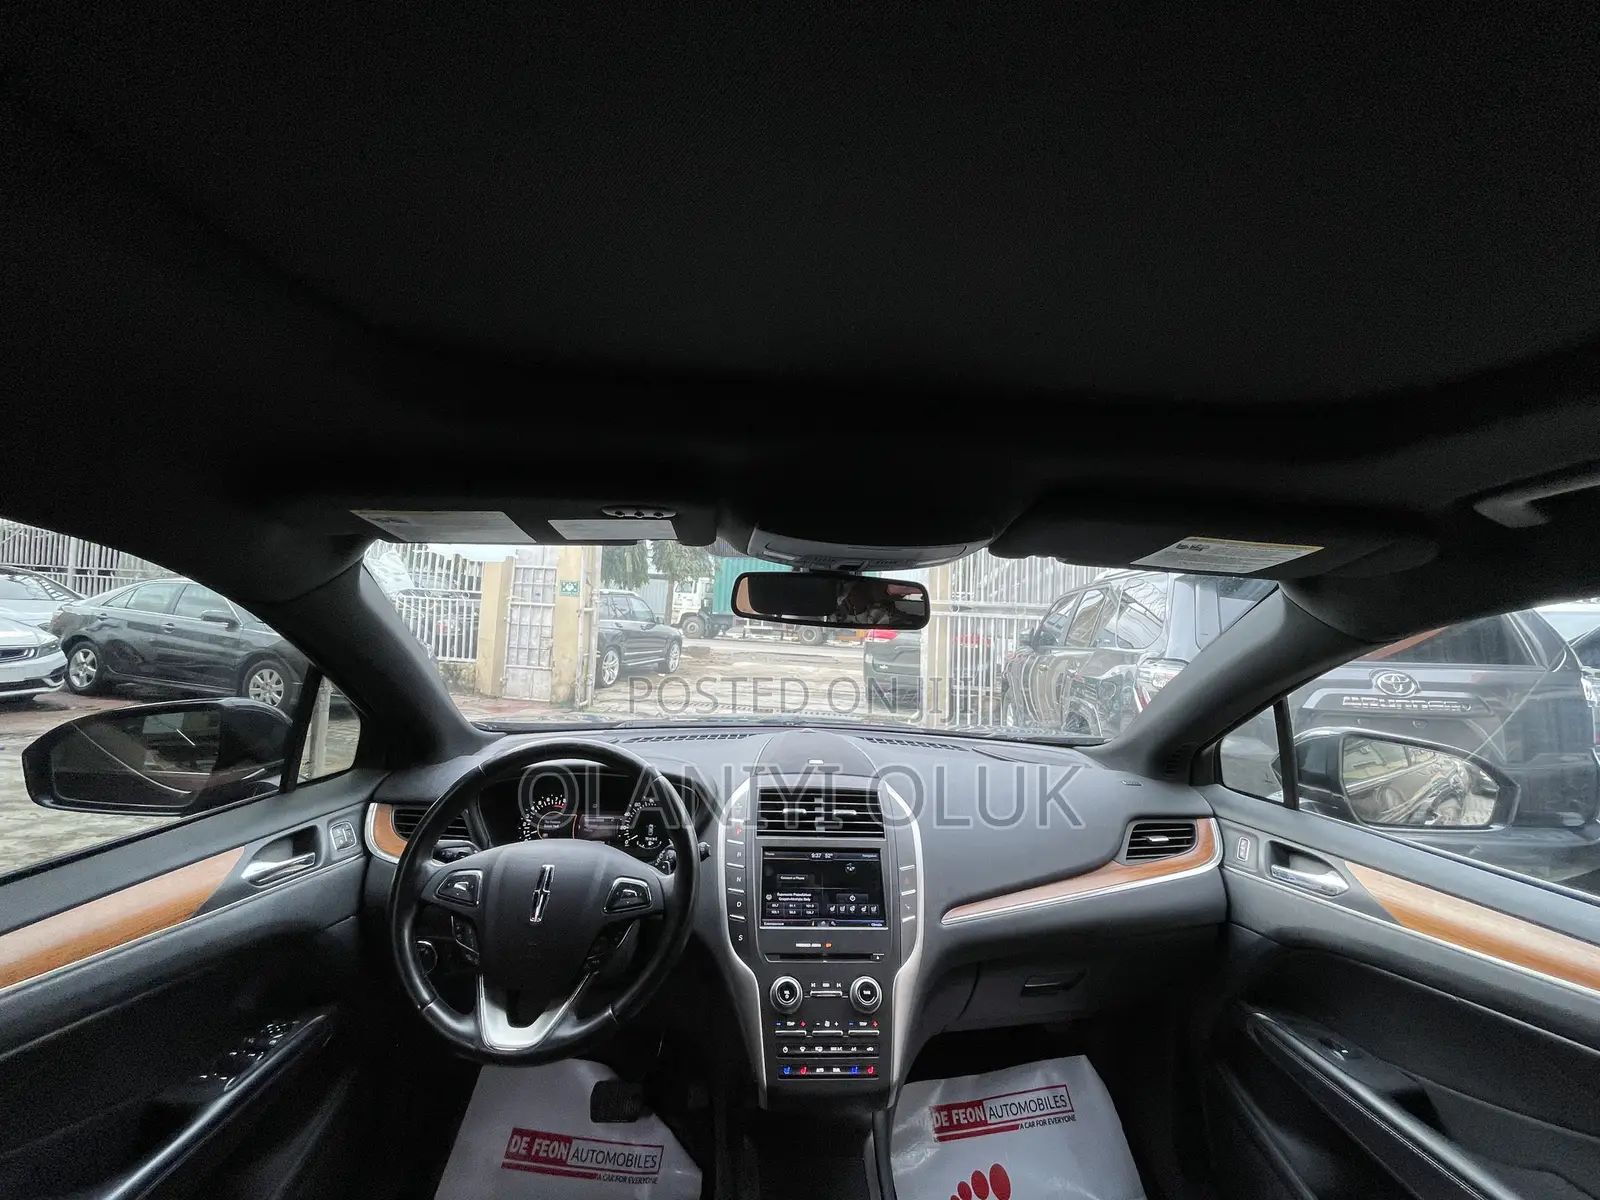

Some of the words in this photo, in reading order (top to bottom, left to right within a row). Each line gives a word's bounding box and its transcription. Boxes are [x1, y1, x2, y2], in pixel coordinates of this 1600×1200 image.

[933, 1111, 949, 1128] DE
[952, 1105, 985, 1125] FEON
[988, 1094, 1068, 1120] AUTOMOBILES
[1025, 1121, 1036, 1129] CAR
[1036, 1119, 1047, 1127] FOR
[1047, 1114, 1077, 1126] EVERYONE
[510, 1135, 529, 1155] DE
[532, 1138, 570, 1161] FEON
[570, 1147, 658, 1169] AUTOMOBILES
